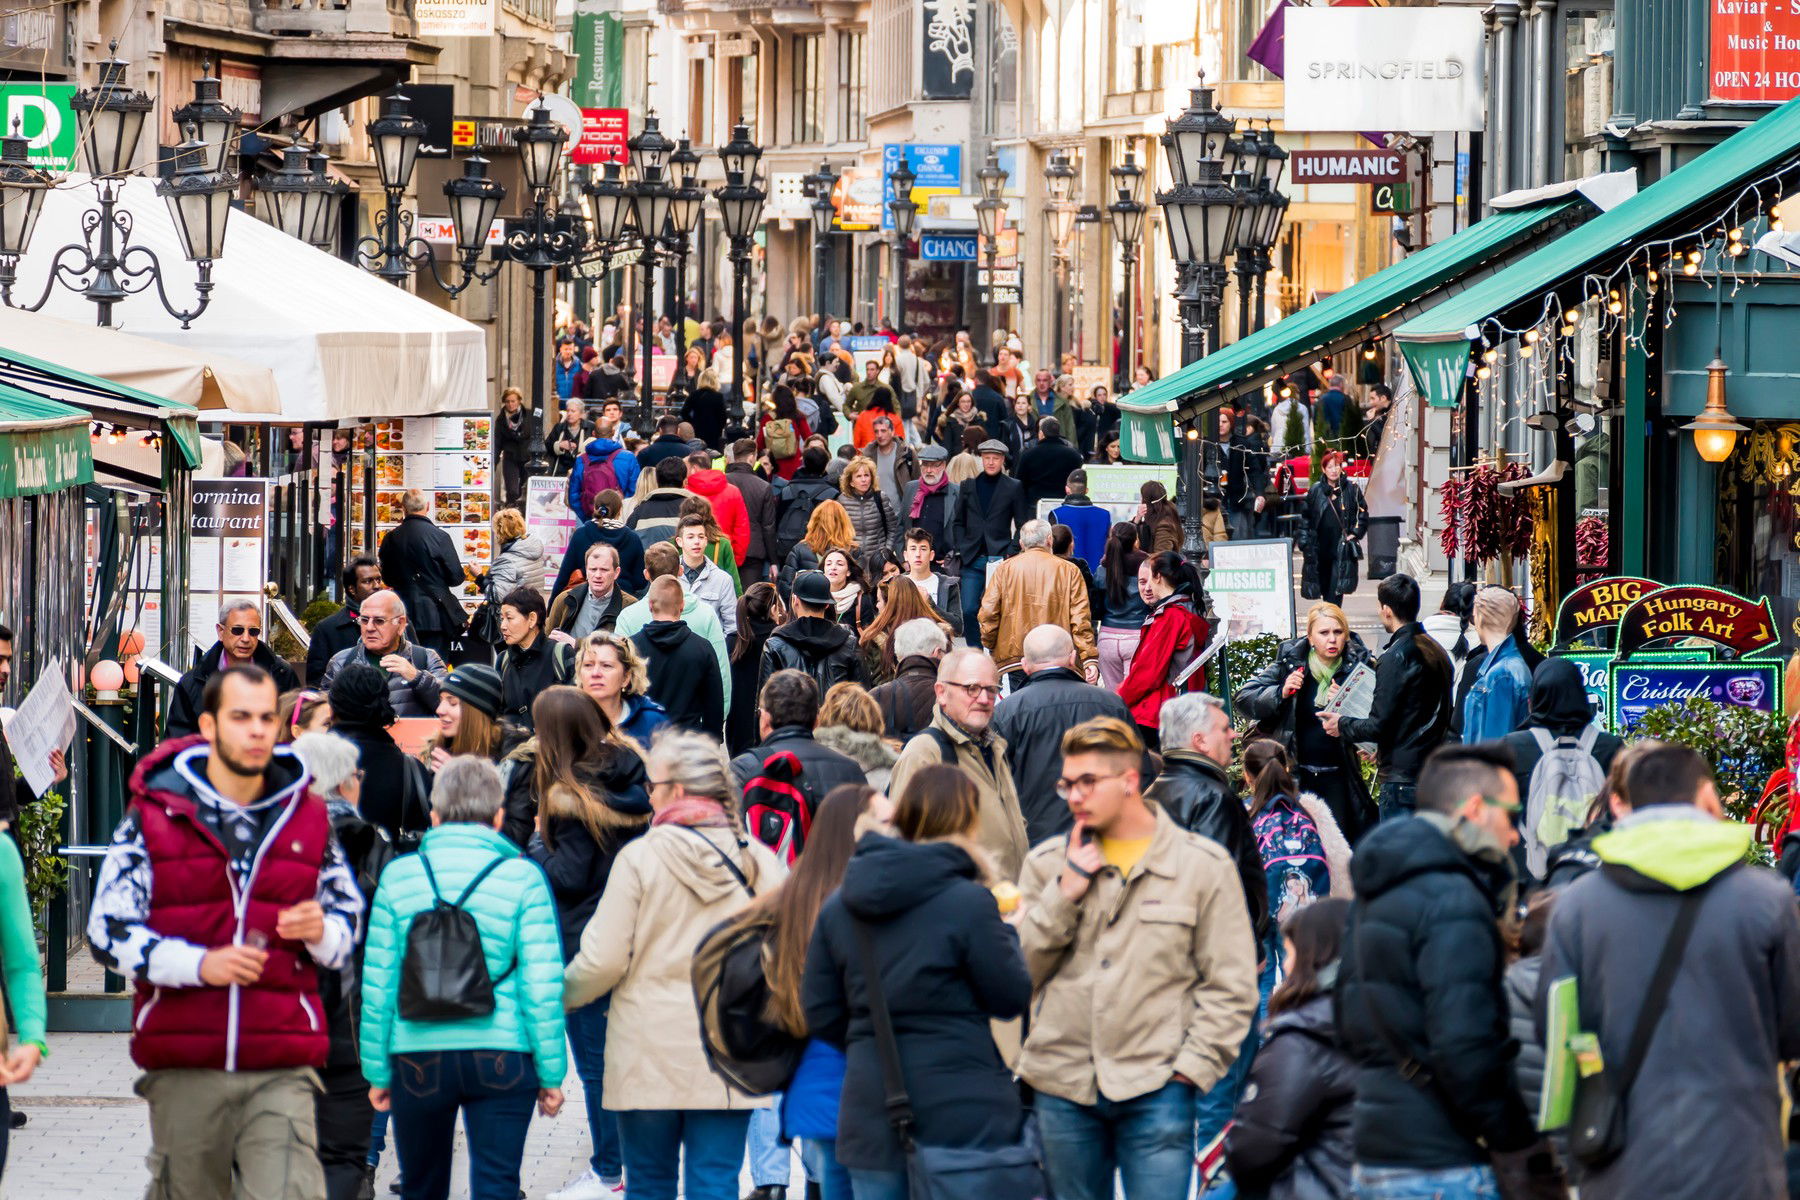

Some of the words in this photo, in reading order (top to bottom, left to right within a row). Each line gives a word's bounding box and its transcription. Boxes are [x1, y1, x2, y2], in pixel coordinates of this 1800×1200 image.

[1717, 0, 1768, 14] Kaviar
[1763, 21, 1773, 32] &
[1728, 34, 1769, 50] Music
[588, 19, 605, 91] Restaurant
[1306, 59, 1464, 80] SPRINGFIELD
[1715, 72, 1750, 88] OPEN
[1754, 72, 1770, 87] 24
[7, 95, 62, 149] D
[1298, 156, 1400, 176] HUMANIC
[983, 272, 1015, 282] CANGE
[981, 292, 1019, 304] MSSAGE
[1215, 571, 1272, 590] MASSAGE
[1591, 582, 1642, 606] BIG
[1643, 597, 1743, 618] Hungary
[1642, 612, 1693, 639] Folk
[1699, 616, 1735, 639] Art
[1622, 674, 1713, 701] Cristals
